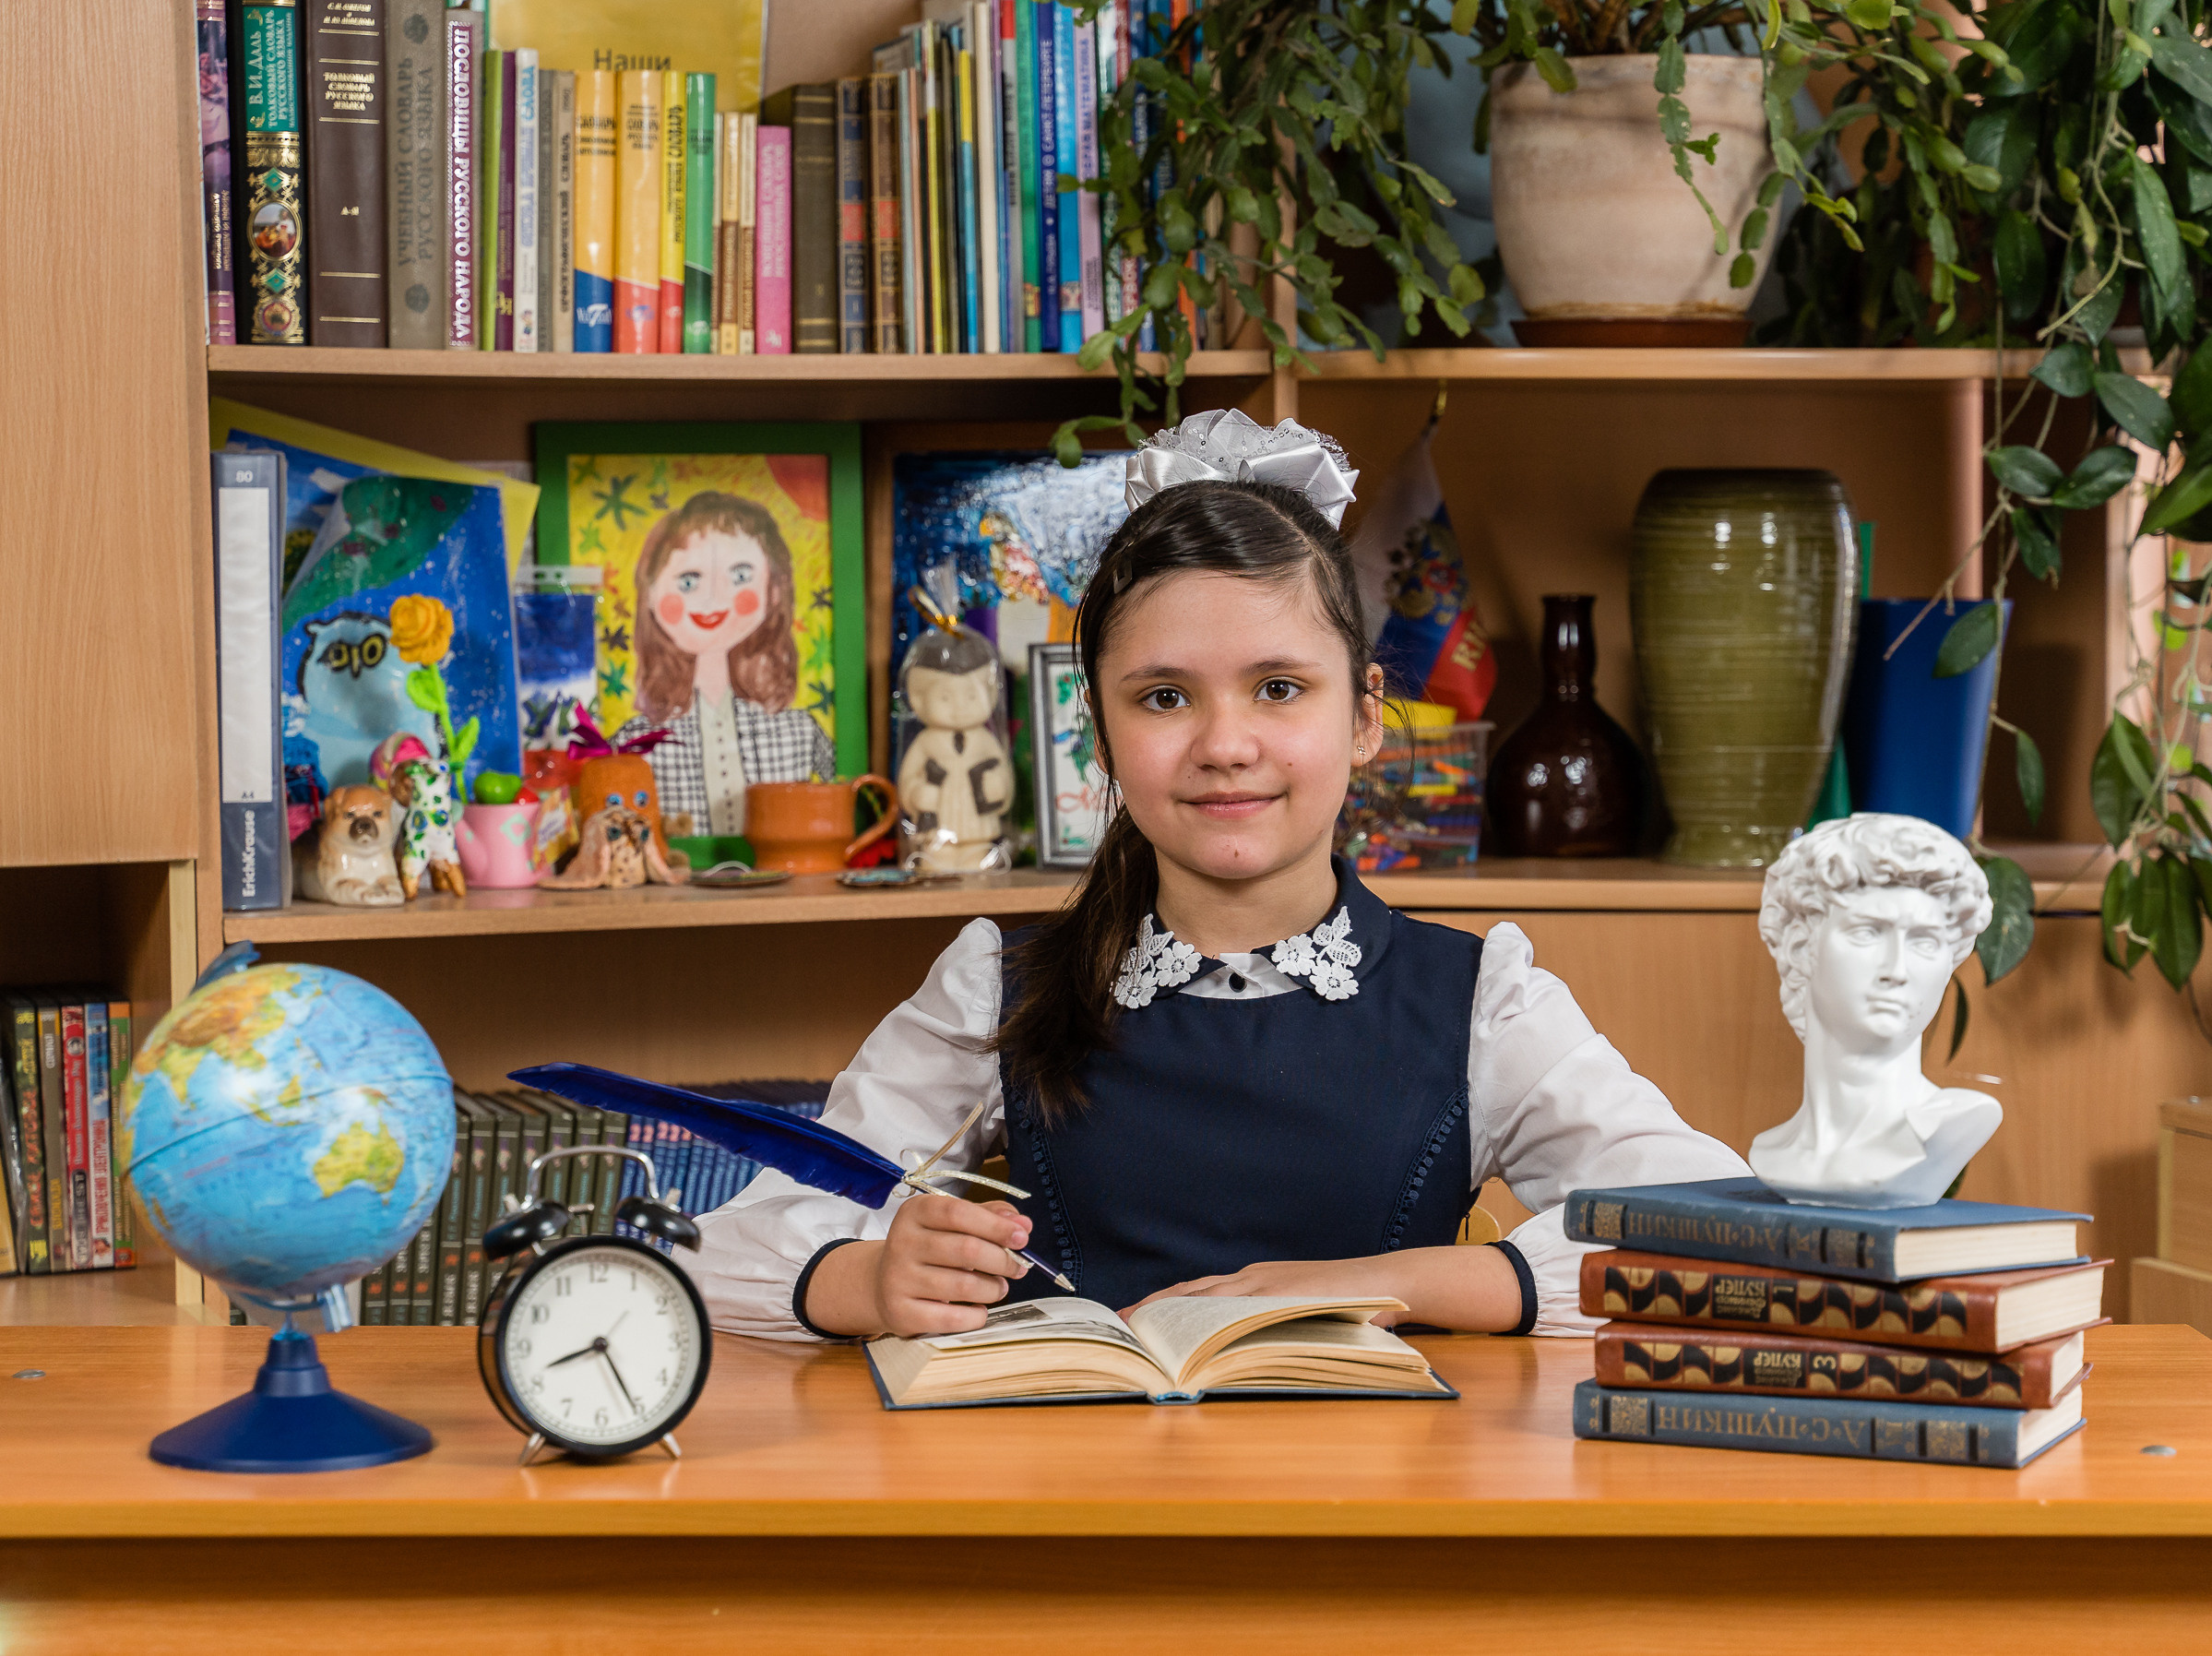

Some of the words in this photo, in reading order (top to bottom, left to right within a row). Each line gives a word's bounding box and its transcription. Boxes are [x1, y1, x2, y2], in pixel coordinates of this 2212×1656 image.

[265, 9, 277, 62] СЛОВАРЬ
[275, 18, 285, 58] ЯЗЫКА
[266, 63, 279, 128] ТОЛКОВЫЙ
[276, 59, 288, 120] РУССКОГО
[452, 29, 470, 155] ПОСЛОВИЦЫ
[520, 66, 535, 121] СЛОВА
[397, 57, 413, 154] СЛОВАРЬ
[417, 66, 433, 139] ЯЗЫКА
[666, 104, 684, 159] СЛОВАРЬ
[396, 160, 415, 267] УЧЕБНЫЙ
[417, 148, 434, 260] РУССКОГО
[454, 158, 470, 256] РУССКОГО
[455, 260, 471, 339] НАРОДА
[243, 809, 256, 899] ErichKrause
[589, 1263, 610, 1283] 12
[629, 1272, 637, 1291] 1
[554, 1276, 572, 1296] 11
[1715, 1279, 1766, 1297] КУПЕР
[530, 1305, 550, 1325] 10
[655, 1296, 668, 1316] 2
[517, 1340, 532, 1359] 9
[669, 1332, 682, 1352] 3
[1753, 1351, 1802, 1368] КУПЕР
[1812, 1355, 1837, 1370] 3
[530, 1375, 544, 1395] 8
[656, 1367, 669, 1386] 4
[561, 1399, 575, 1418] 7
[634, 1396, 646, 1415] 5
[595, 1408, 609, 1428] 6
